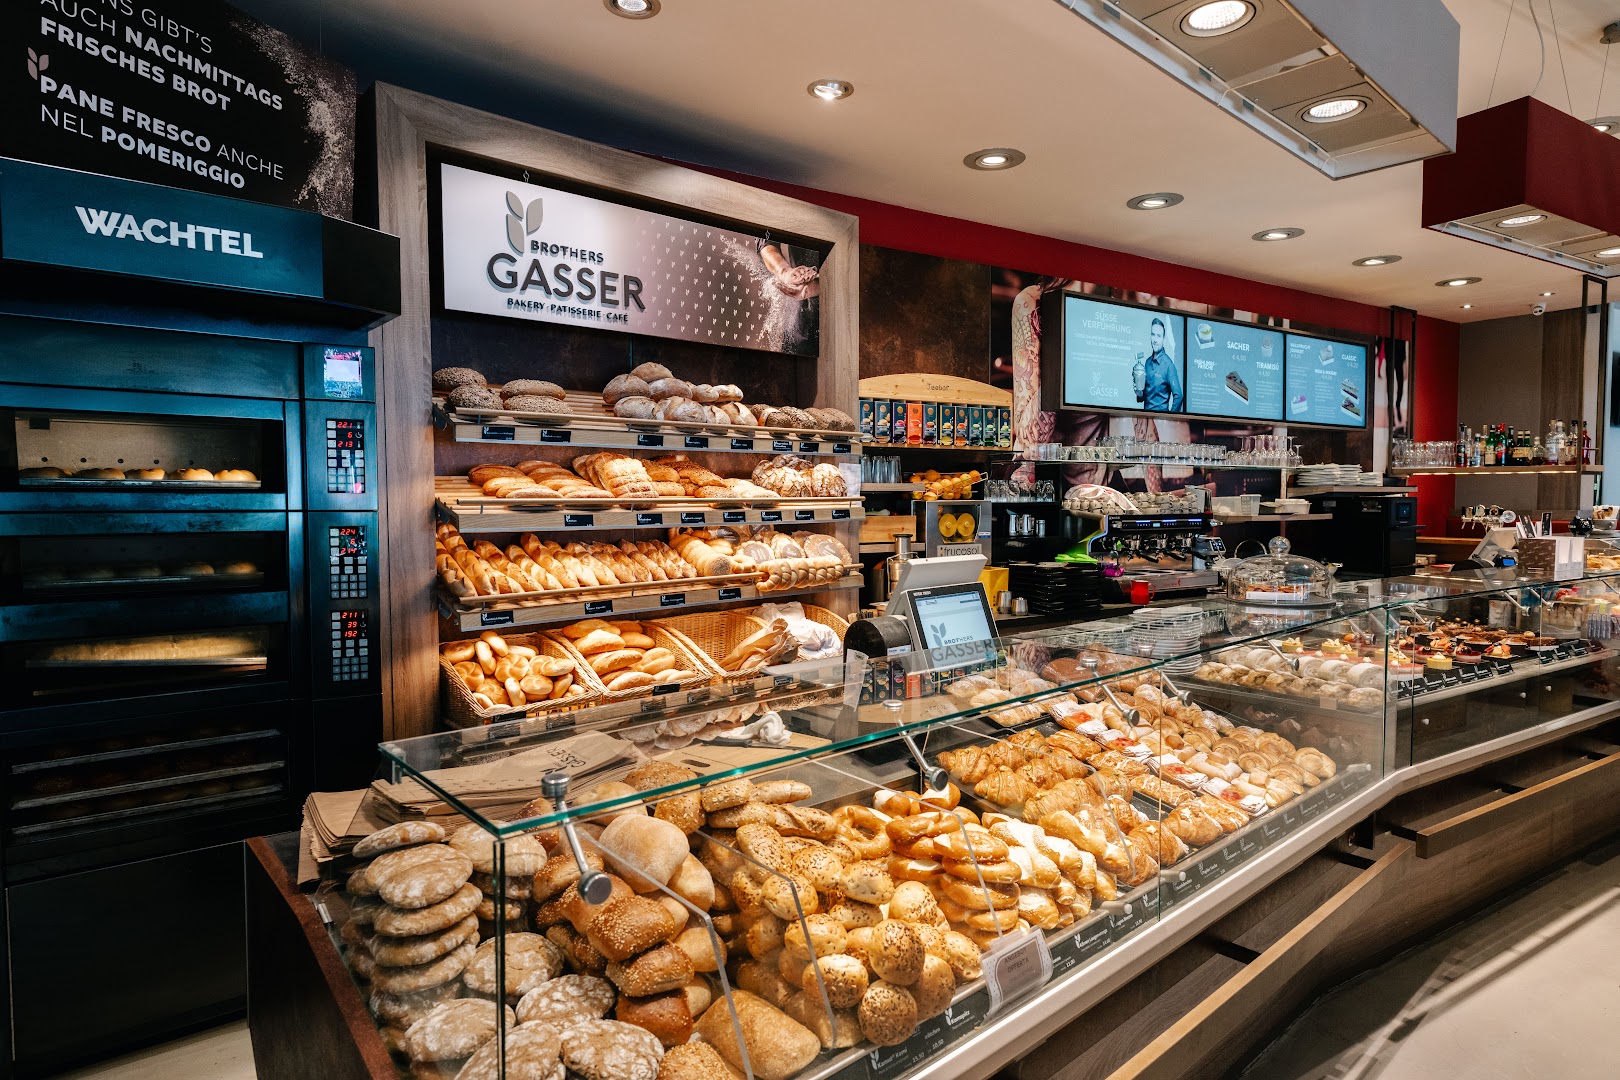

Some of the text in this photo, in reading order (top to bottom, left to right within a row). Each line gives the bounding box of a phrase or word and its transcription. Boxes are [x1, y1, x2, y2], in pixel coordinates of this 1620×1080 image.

[41, 16, 231, 112] FRISCHES BROT
[125, 26, 283, 111] NACHMITTAGS
[41, 75, 284, 181] PANE FRESCO ANCHE
[41, 104, 246, 189] NEL POMERIGGIO
[75, 205, 264, 259] WACHTEL
[530, 239, 604, 264] BROTHERS
[486, 252, 646, 312] GASSER
[507, 297, 629, 324] BAKERY PATISSERIE CAFÉ
[1226, 340, 1250, 352] SACHER
[1089, 386, 1119, 398] GASSER
[337, 421, 353, 429] 221
[347, 431, 353, 439] 6
[337, 440, 353, 448] 213
[342, 611, 357, 619] 211
[943, 635, 974, 645] BROTHERS
[931, 639, 993, 662] GASSER
[1004, 946, 1027, 964] ANGEBOT
[1007, 957, 1029, 973] OFFERTA
